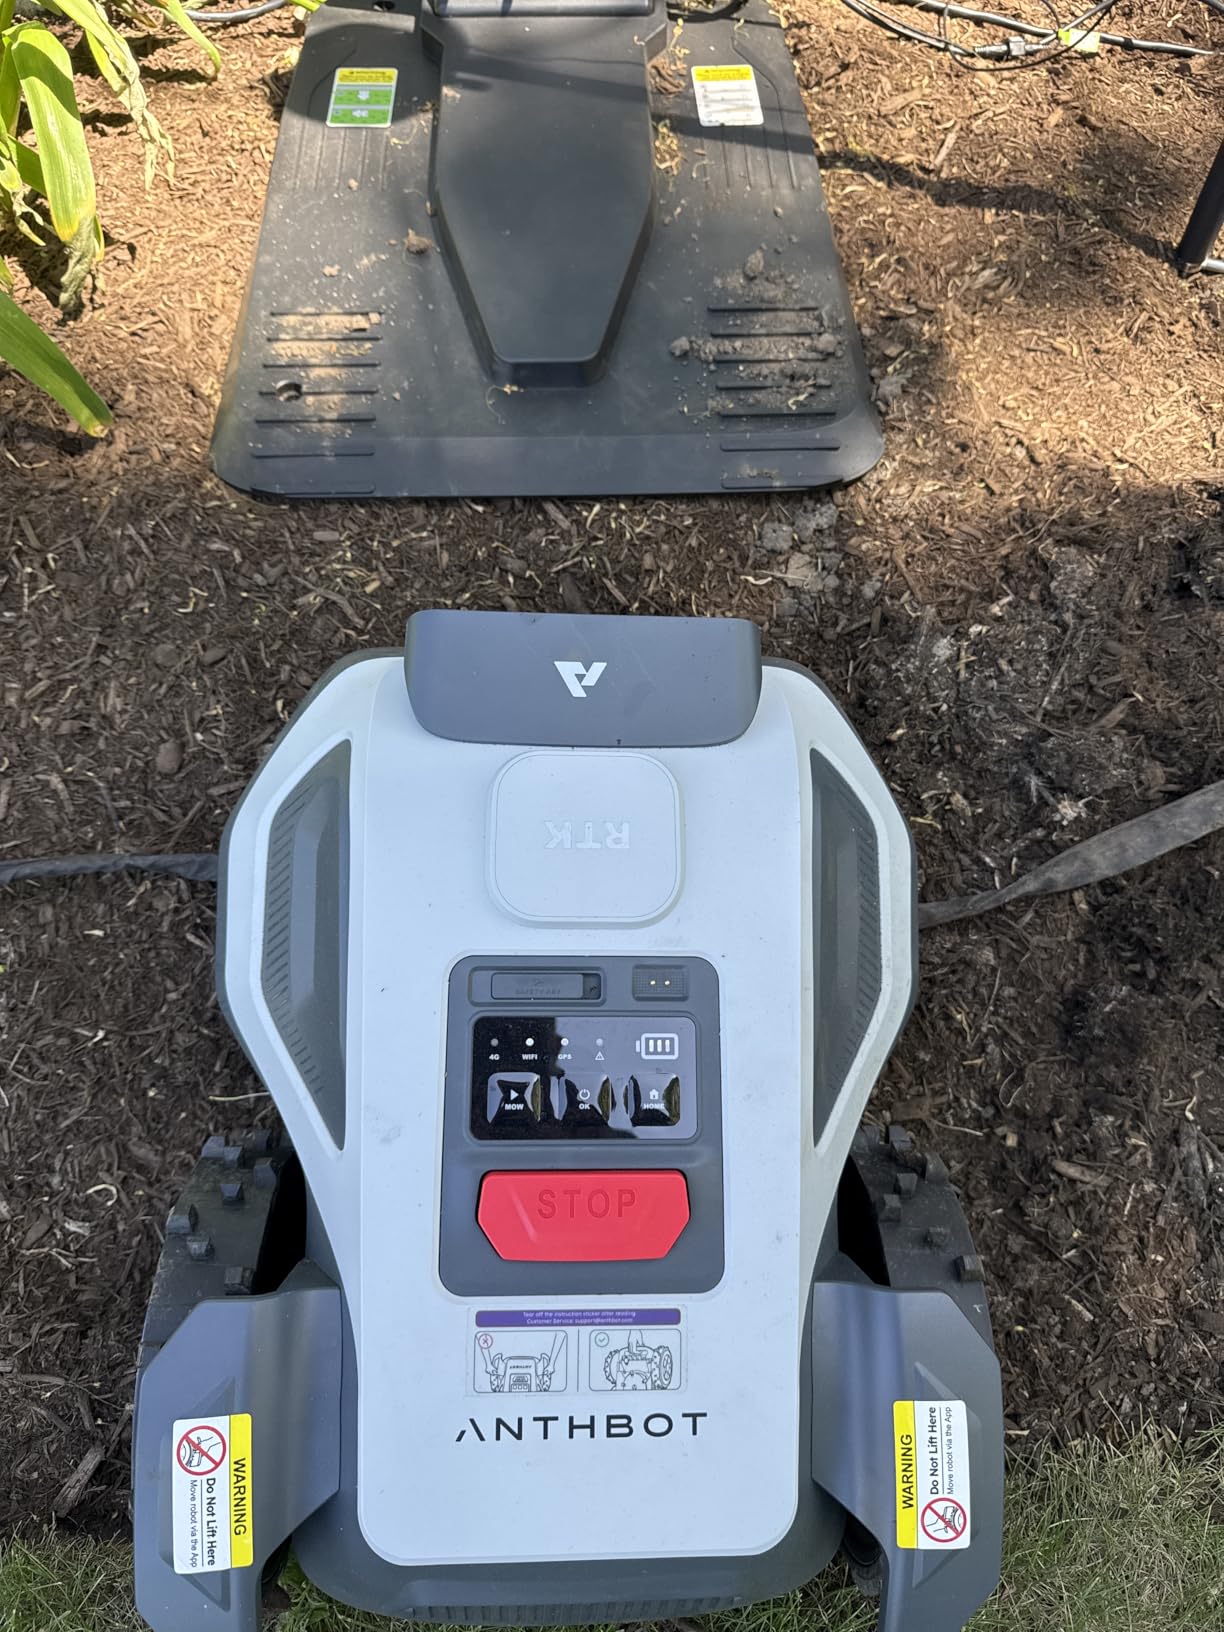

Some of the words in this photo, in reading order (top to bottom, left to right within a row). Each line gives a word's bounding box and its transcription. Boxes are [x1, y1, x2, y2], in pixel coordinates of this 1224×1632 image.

[544, 820, 630, 849] RTK
[504, 1103, 524, 1111] MOW
[537, 1188, 636, 1219] STOP
[928, 1406, 937, 1433] Here
[944, 1406, 952, 1423] App
[455, 1412, 708, 1442] ANTHBOT
[928, 1436, 938, 1454] Lift
[945, 1438, 953, 1450] via
[900, 1434, 914, 1509] WARNING
[929, 1457, 939, 1477] Not
[190, 1480, 198, 1501] Move
[206, 1477, 216, 1494] Do
[930, 1480, 939, 1495] Do
[233, 1457, 247, 1536] WARNING
[190, 1503, 198, 1524] robot
[206, 1497, 216, 1517] Not
[190, 1526, 198, 1537] via
[206, 1520, 218, 1538] Lift
[190, 1538, 198, 1551] the
[207, 1541, 217, 1566] Here
[189, 1553, 199, 1568] App
